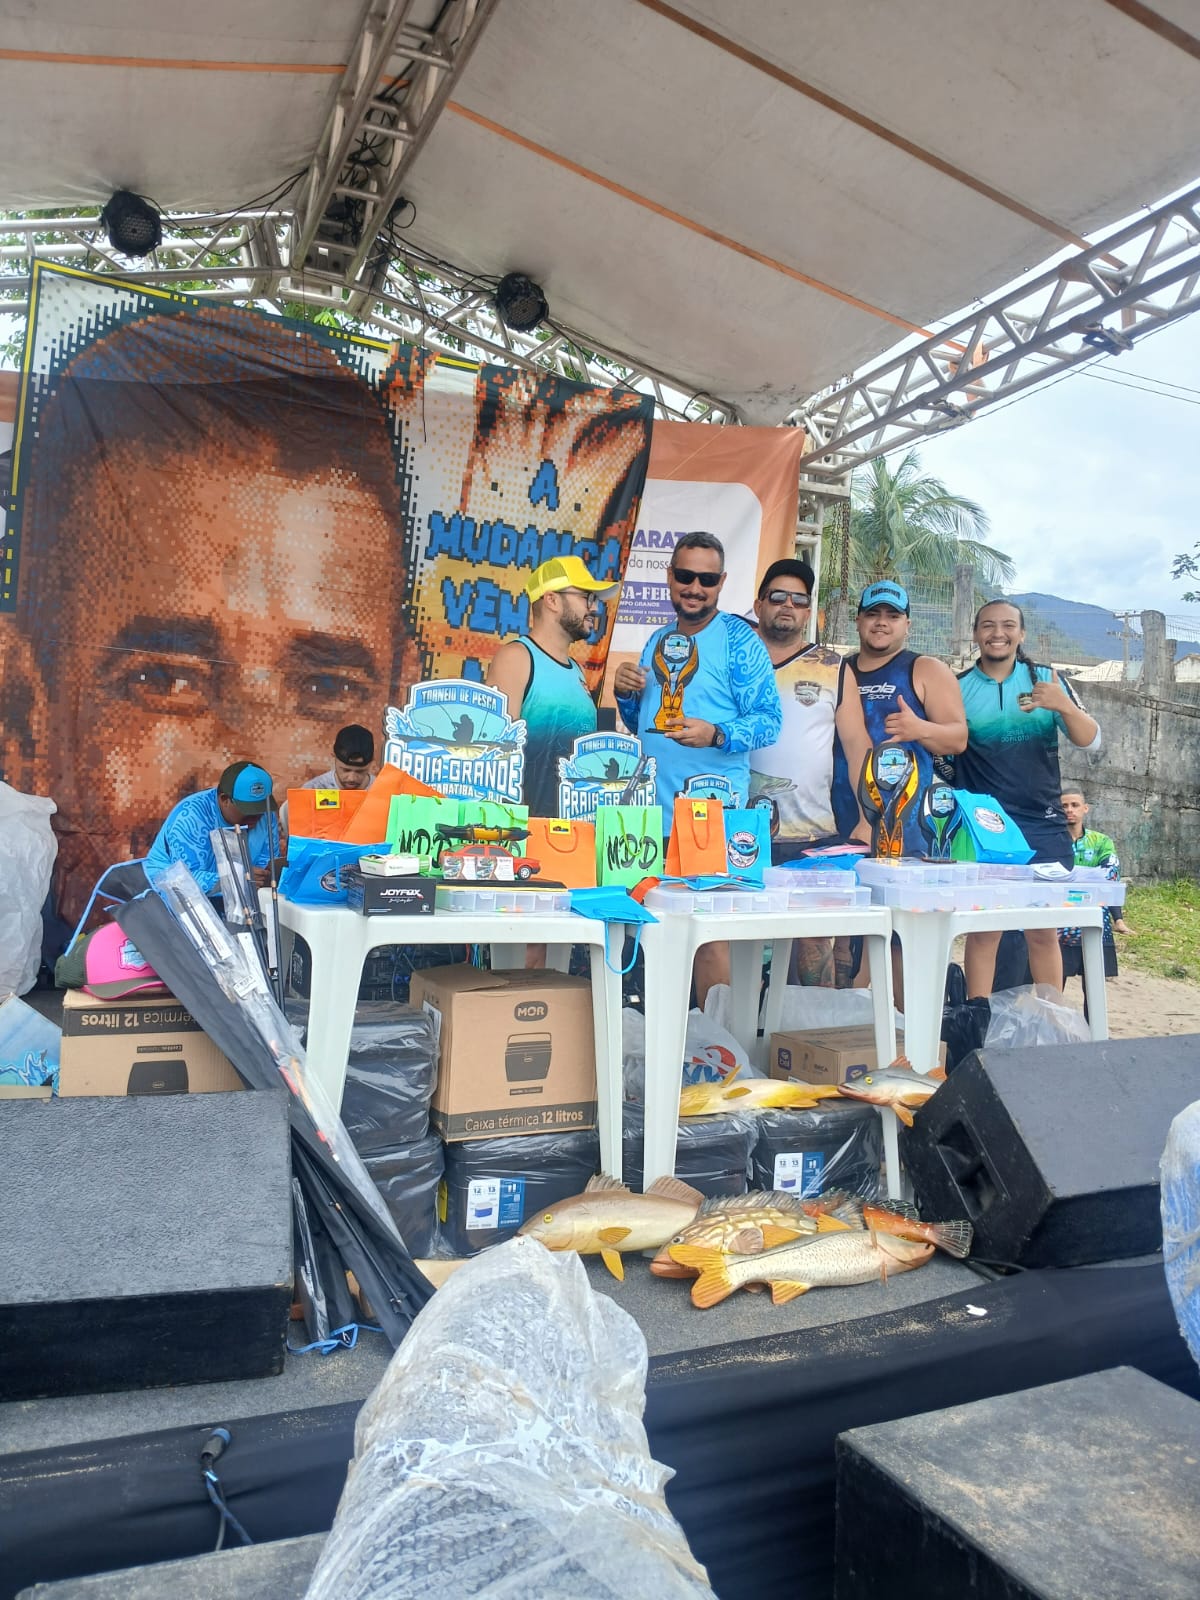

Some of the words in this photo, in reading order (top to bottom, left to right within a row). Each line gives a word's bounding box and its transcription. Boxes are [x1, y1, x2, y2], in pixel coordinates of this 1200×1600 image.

[528, 459, 560, 511] A
[629, 554, 643, 568] da
[421, 687, 457, 704] TORNEIO
[460, 689, 469, 702] DE
[472, 692, 497, 711] PESCA
[867, 693, 892, 701] Sport
[562, 785, 599, 819] PRAIA
[604, 784, 654, 806] GRNDE
[380, 889, 423, 897] JOYFOX
[517, 1006, 545, 1017] MOR
[81, 1013, 120, 1028] litros
[124, 1013, 139, 1028] 12
[465, 1117, 495, 1131] Caixa
[498, 1113, 539, 1128] térmica
[541, 1111, 553, 1124] 12
[555, 1110, 583, 1123] litros
